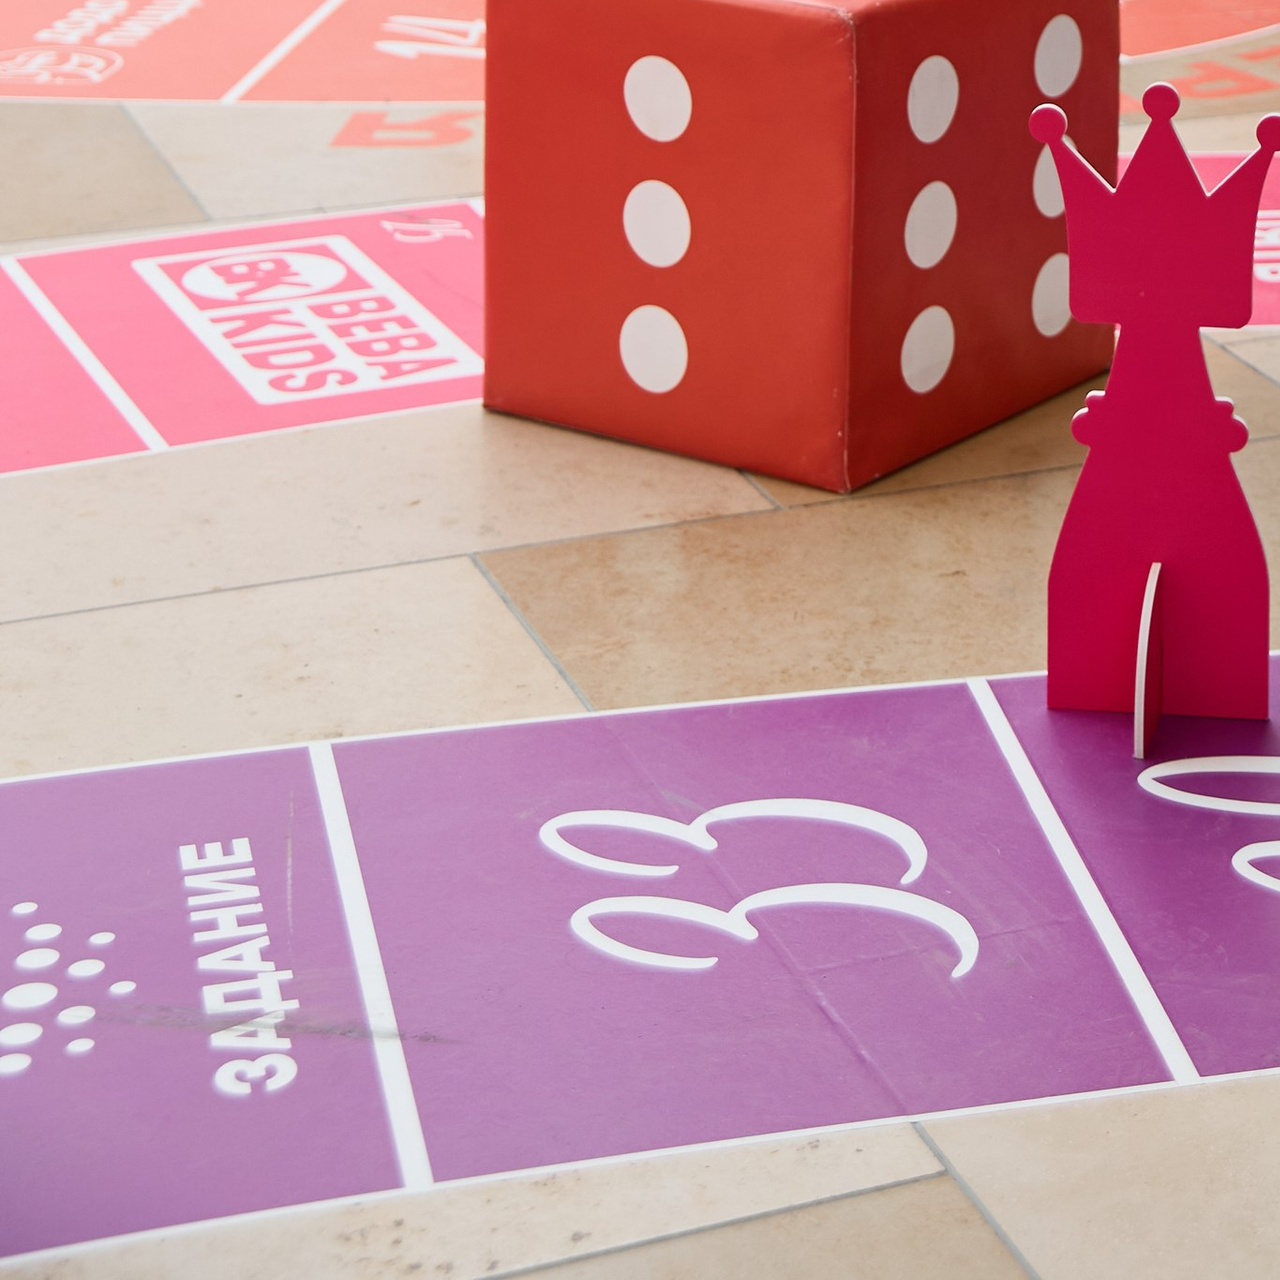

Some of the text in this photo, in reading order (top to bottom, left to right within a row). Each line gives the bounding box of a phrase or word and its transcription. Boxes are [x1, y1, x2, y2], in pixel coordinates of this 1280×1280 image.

[208, 307, 359, 394] KIDS
[308, 289, 459, 383] BEBA
[539, 797, 979, 980] 33
[179, 837, 300, 1096] ЗАДАНИЕ
